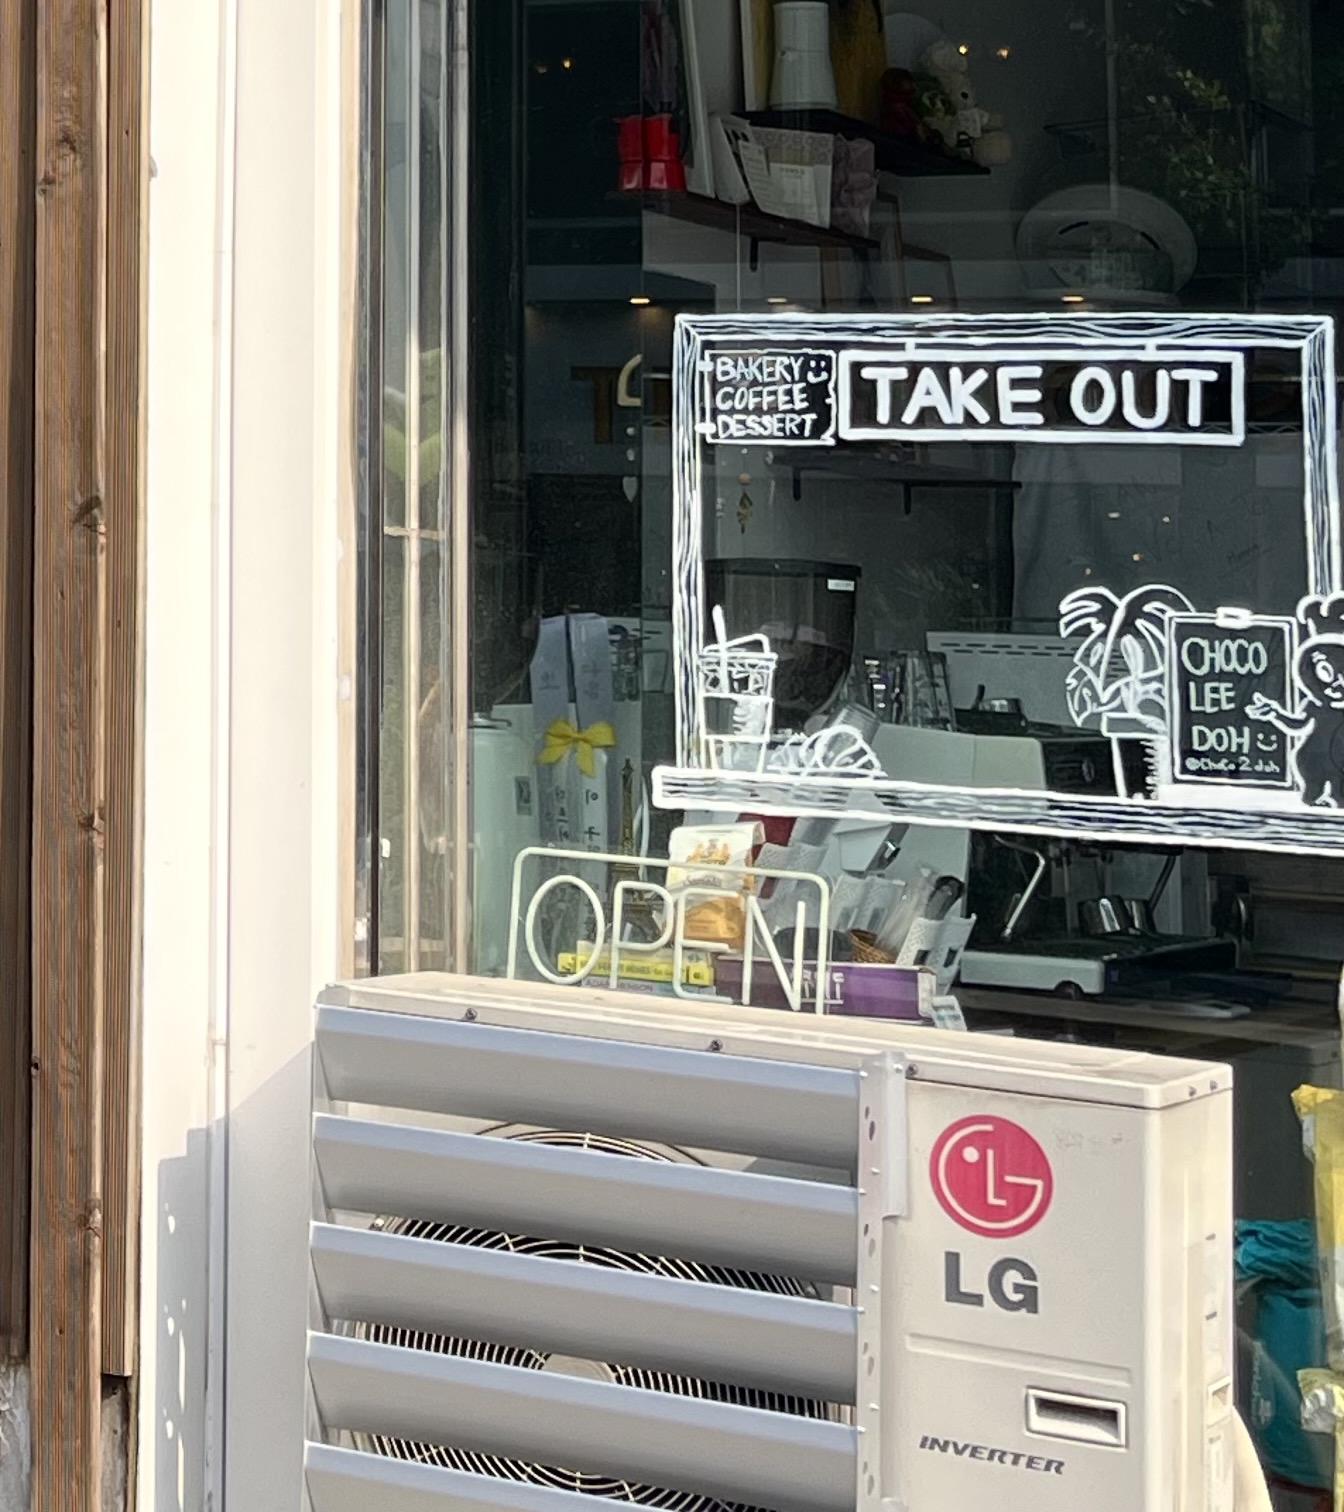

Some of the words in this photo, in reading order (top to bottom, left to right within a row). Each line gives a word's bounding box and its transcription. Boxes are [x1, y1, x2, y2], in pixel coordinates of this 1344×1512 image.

[715, 356, 804, 383] BAKERY
[715, 385, 809, 410] COFFEE
[859, 365, 1045, 426] TAKE
[1069, 366, 1219, 430] OUT
[715, 411, 817, 438] DESSERT
[1181, 637, 1268, 676] CHOCO
[1189, 681, 1236, 714] LEE
[1191, 724, 1251, 754] DOH
[525, 874, 806, 1012] OPEN
[944, 1251, 1039, 1314] LG
[919, 1434, 1066, 1476] INVERTER
